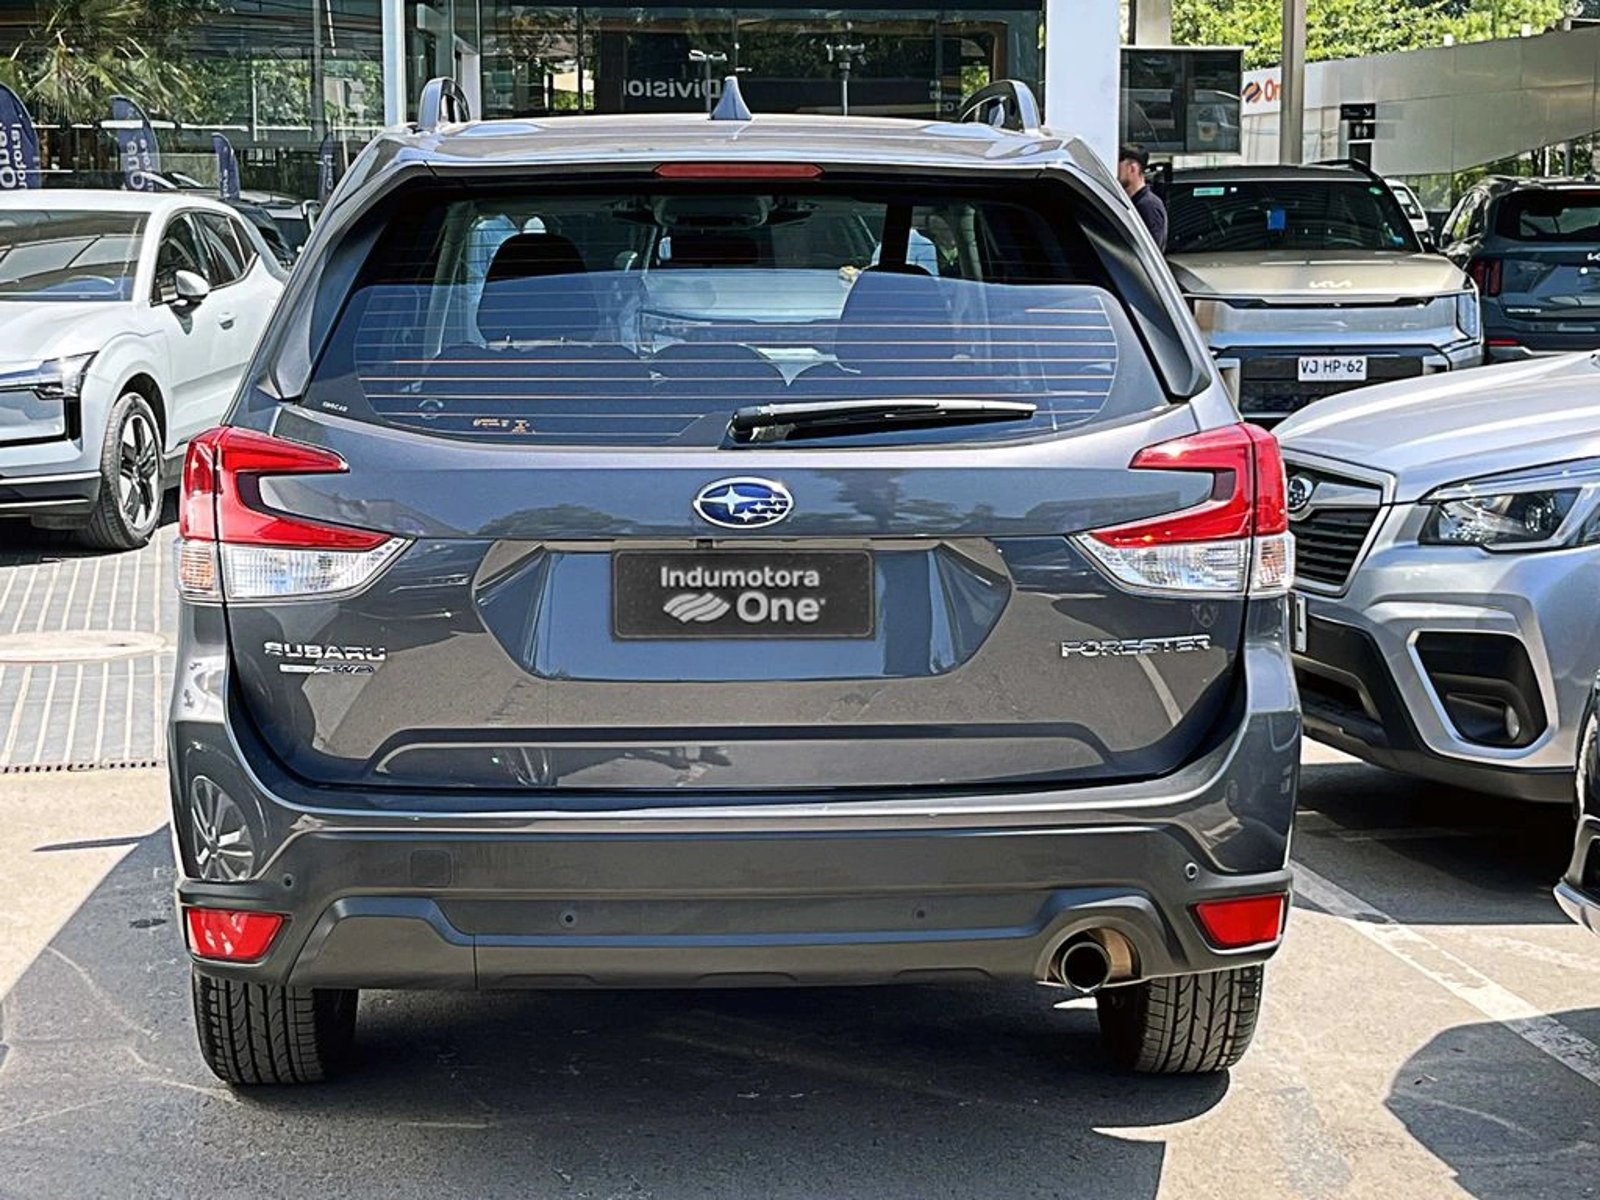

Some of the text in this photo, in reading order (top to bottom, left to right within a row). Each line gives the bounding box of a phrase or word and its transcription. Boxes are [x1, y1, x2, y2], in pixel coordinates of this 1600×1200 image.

[1301, 360, 1318, 373] VJ
[661, 566, 820, 588] Indumotora
[736, 591, 820, 622] One
[264, 641, 386, 661] SUBARU
[1062, 634, 1211, 657] FORESTER
